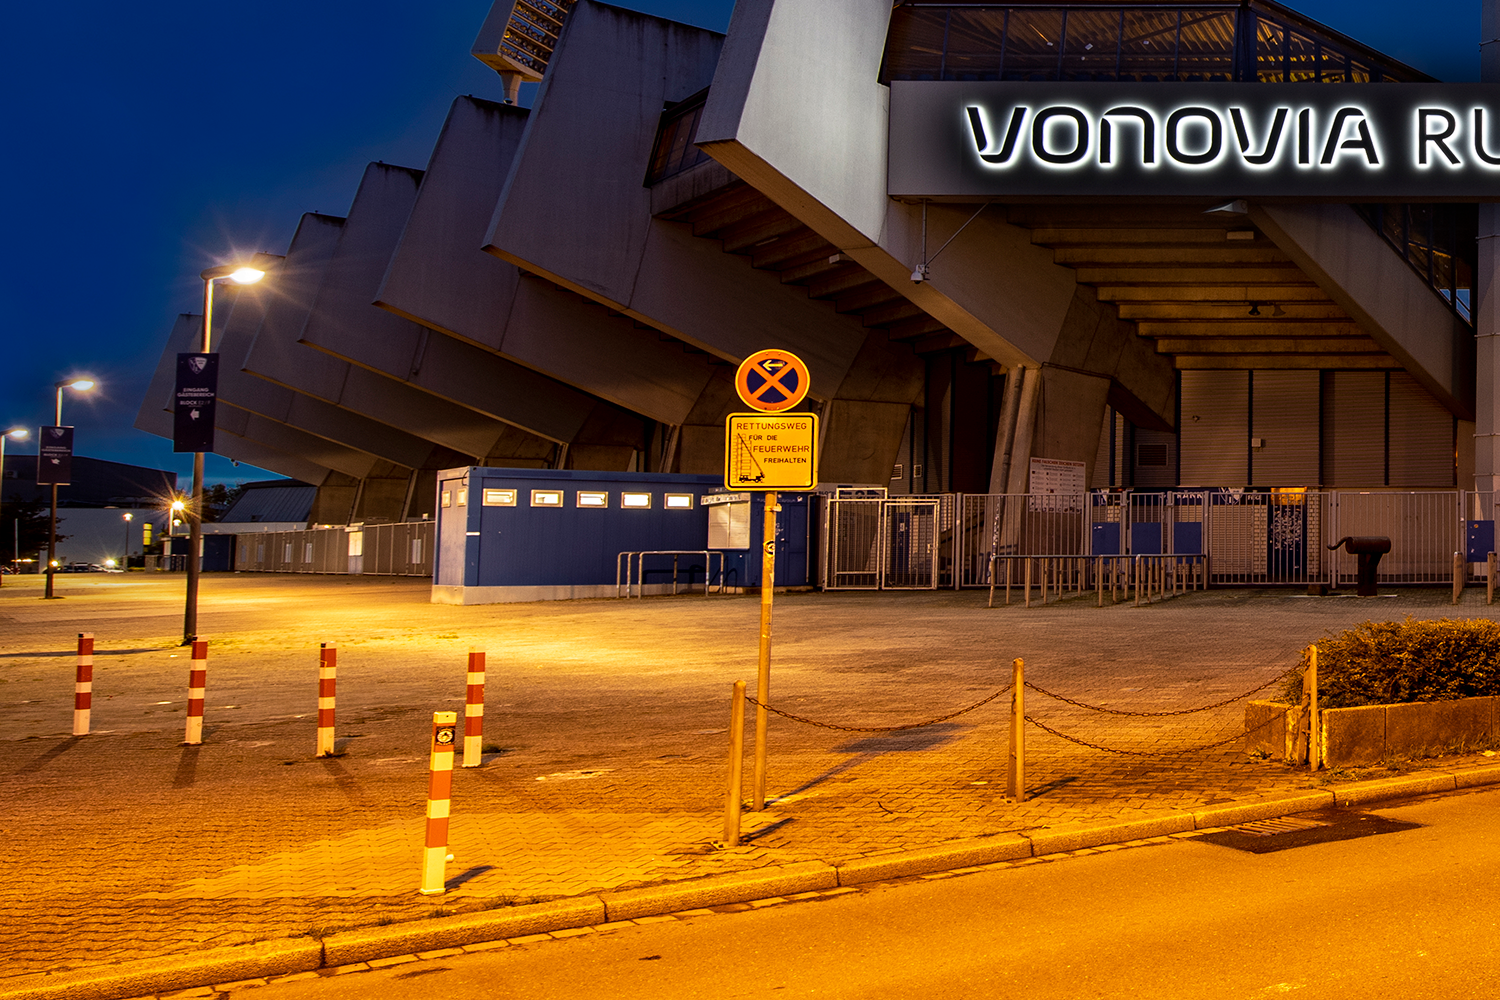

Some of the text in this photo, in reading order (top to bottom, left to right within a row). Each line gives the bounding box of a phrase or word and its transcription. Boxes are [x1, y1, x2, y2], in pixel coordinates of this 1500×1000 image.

[966, 105, 1380, 165] VONOVIA
[736, 422, 807, 430] RETTUNGSWEG
[748, 433, 763, 441] FÜR
[753, 445, 810, 453] FEUERWEHR
